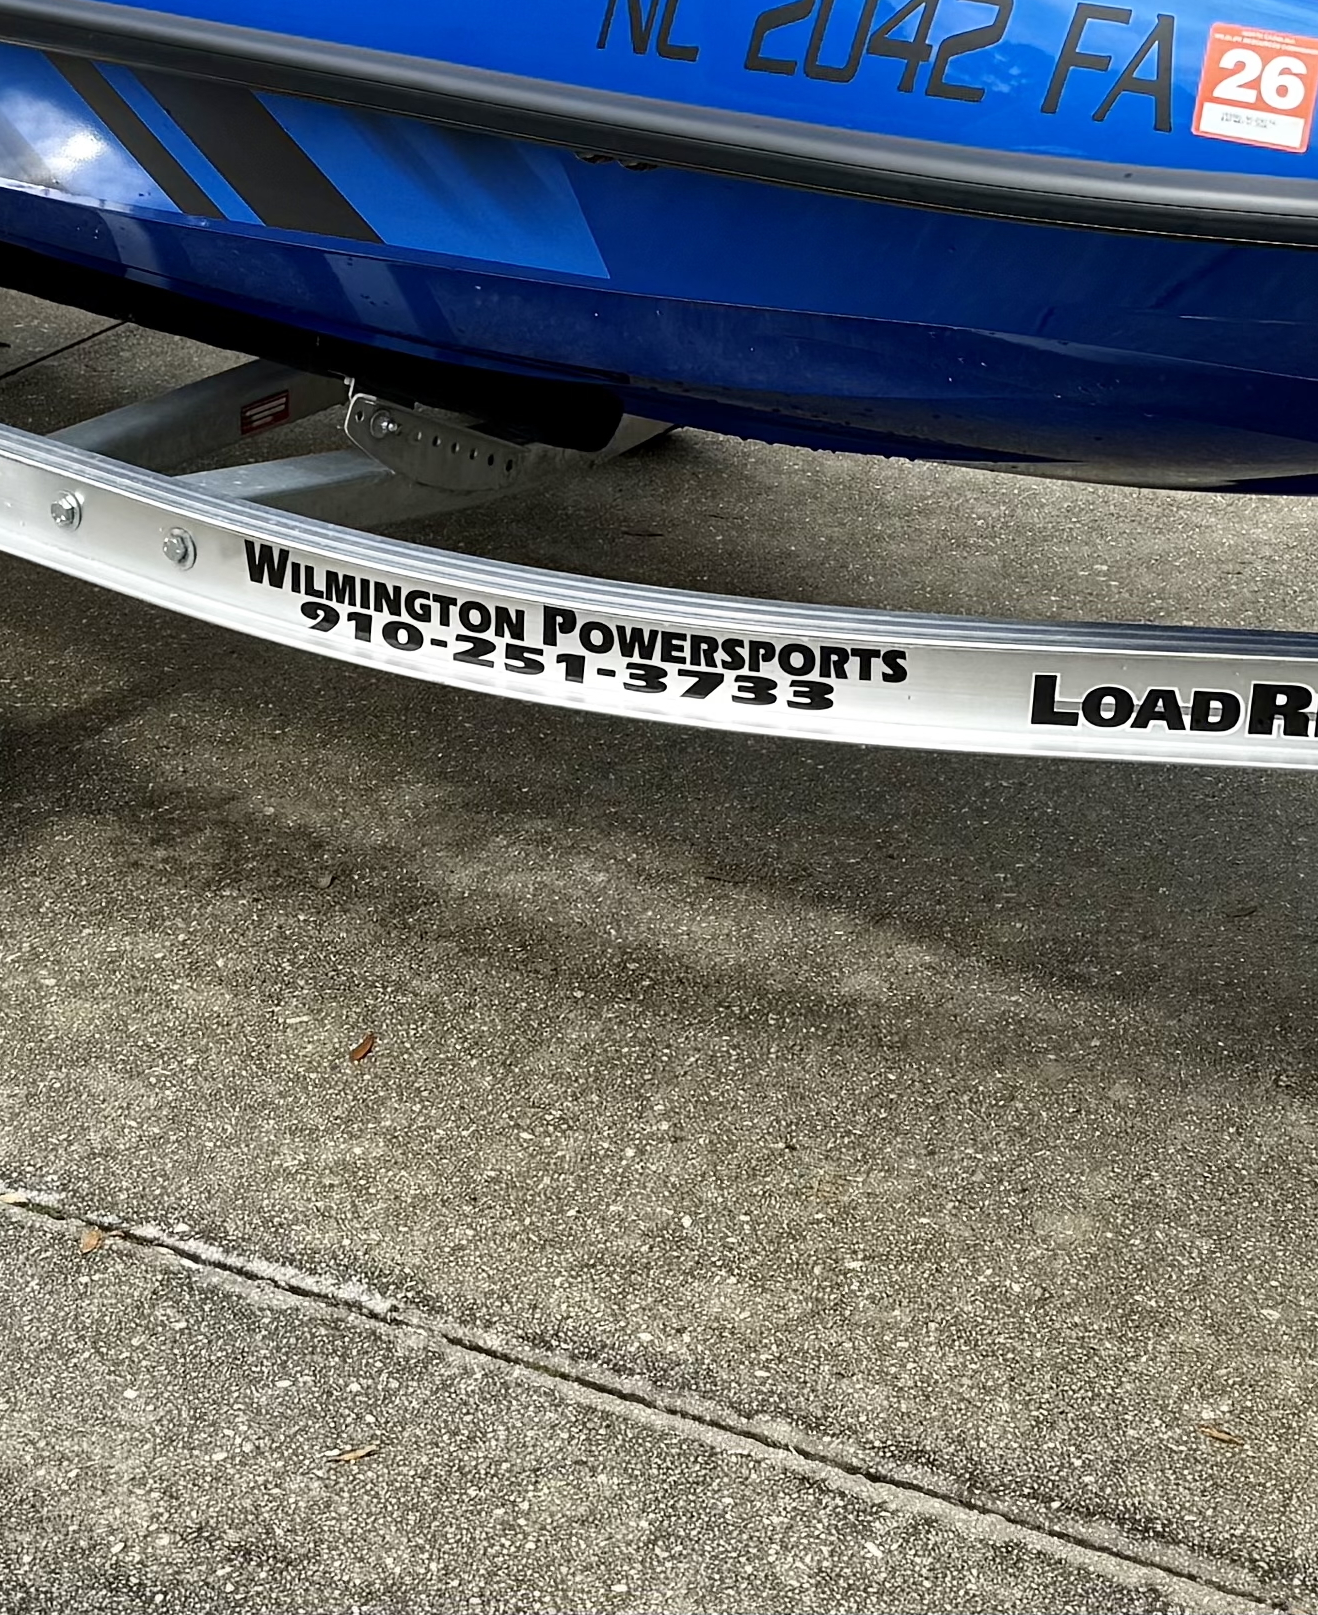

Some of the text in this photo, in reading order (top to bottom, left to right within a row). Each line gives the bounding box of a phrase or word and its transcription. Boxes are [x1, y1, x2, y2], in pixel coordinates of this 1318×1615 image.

[1040, 1, 1176, 133] FA
[1212, 47, 1308, 111] 26
[244, 539, 908, 683] WILMINGTON POWERSPORTS
[300, 601, 834, 711] 910-251-3733
